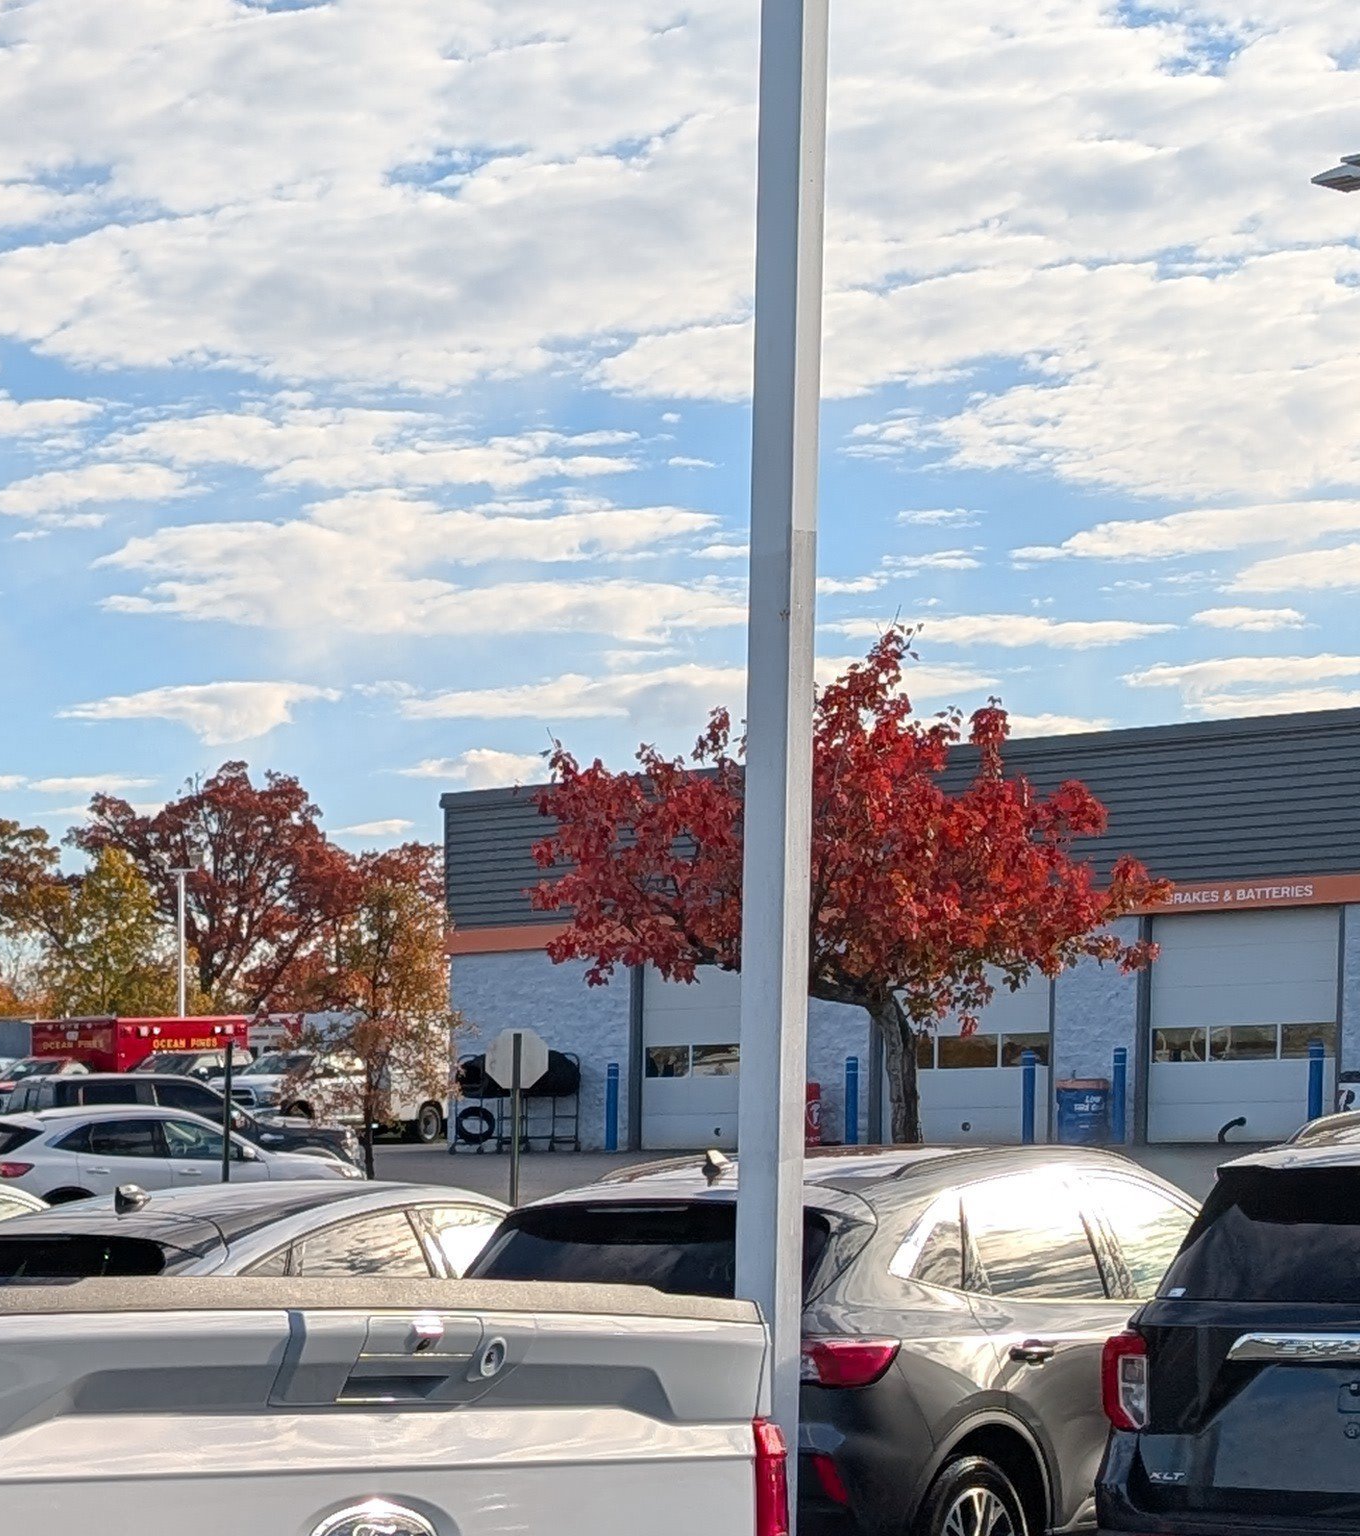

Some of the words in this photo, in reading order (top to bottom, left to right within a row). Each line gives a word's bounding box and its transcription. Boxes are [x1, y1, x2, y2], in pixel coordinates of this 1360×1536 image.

[1223, 890, 1232, 902] &
[1236, 885, 1314, 901] BATTERIES
[152, 1038, 186, 1049] OCEAN
[1149, 1472, 1185, 1480] XLT
